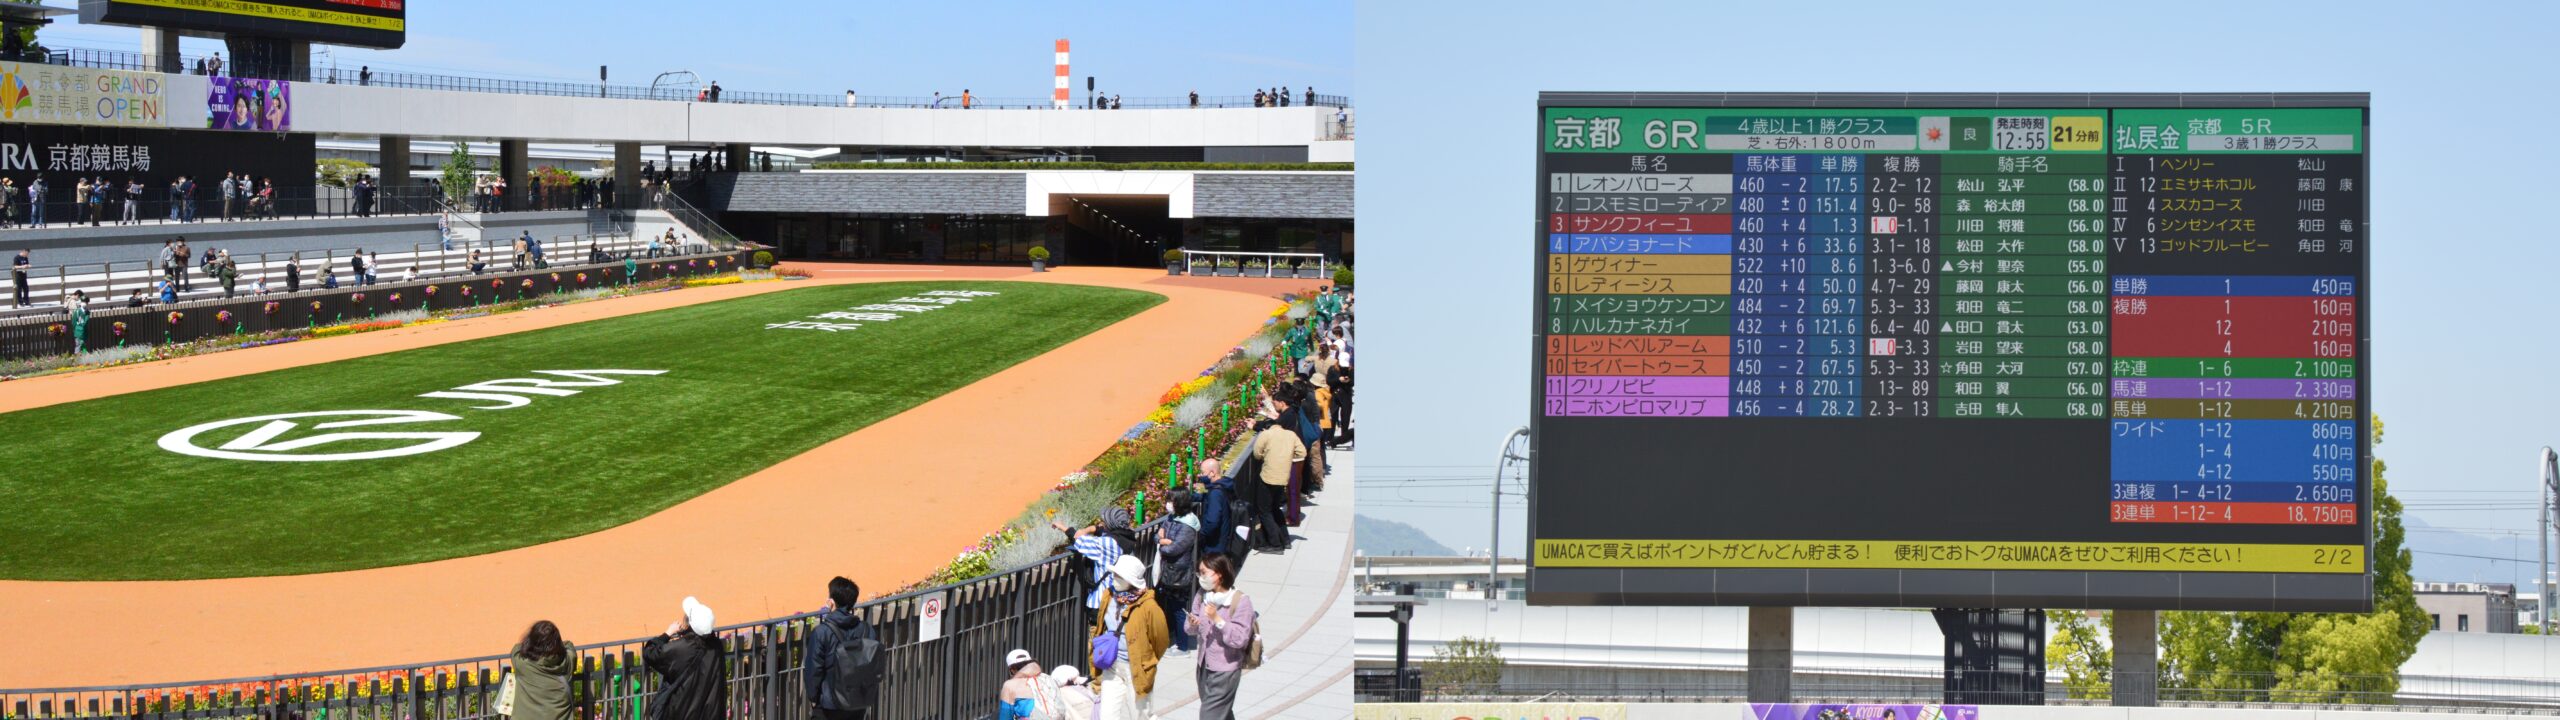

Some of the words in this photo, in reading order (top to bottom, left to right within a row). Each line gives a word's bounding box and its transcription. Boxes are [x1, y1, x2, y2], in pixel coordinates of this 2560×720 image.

[97, 75, 159, 94] GRAND
[214, 85, 226, 94] HERO
[218, 94, 224, 103] IS
[39, 95, 90, 115] 競馬場
[97, 97, 157, 119] OPEN
[1998, 118, 2043, 129] 発走時刻
[2188, 119, 2223, 136] 京都
[2240, 119, 2274, 136] 5R
[1555, 118, 1620, 148] 京都
[1645, 121, 1697, 147] 6R
[1738, 119, 1886, 135] 4歳以上1勝クラス
[1964, 128, 1976, 140] 良
[1997, 132, 2044, 150] 12:55
[2117, 126, 2179, 150] 払戻金
[2225, 137, 2318, 150] 3歳1勝クラス
[48, 143, 151, 171] 京都競馬場
[1631, 156, 1667, 171] 馬名
[1747, 156, 1796, 171] 馬体重
[1822, 156, 1857, 172] 単勝
[1884, 157, 1920, 172] 複勝
[1998, 156, 2048, 172] 騎手名
[2160, 159, 2214, 173] ヘンリー
[2298, 158, 2325, 171] 松山
[1573, 176, 1693, 193] レオンバローズ
[1740, 177, 1764, 192] 460
[1826, 178, 1857, 192] 17.5
[1958, 179, 1984, 191] 松山
[1998, 179, 2024, 192] 弘平
[2069, 179, 2104, 192] (58.0)
[2141, 177, 2155, 192] 12
[2162, 178, 2255, 190] エミサキホコル
[2298, 178, 2324, 191] 藤岡
[2340, 179, 2352, 191] 康
[1576, 197, 1726, 212] コスモミローディア
[1740, 197, 1763, 212] 480
[1817, 198, 1856, 213] 151.4
[1957, 199, 1970, 211] 森
[1984, 199, 2024, 212] 裕太朗
[2069, 199, 2104, 212] (58.0)
[2298, 199, 2324, 211] 川田
[1576, 217, 1692, 232] サンクフィーユ
[1740, 218, 1763, 232] 460
[1834, 218, 1856, 233] 1.3
[1871, 218, 1930, 234] 1.0-1.1
[1957, 220, 1983, 232] 川田
[2068, 219, 2103, 232] (56.0)
[2298, 219, 2324, 232] 和田
[2340, 219, 2352, 232] 竜
[1739, 238, 1763, 253] 430
[1825, 238, 1856, 253] 33.6
[1957, 240, 1983, 252] 松田
[1998, 240, 2024, 252] 大作
[2068, 240, 2103, 252] (58.0)
[2140, 238, 2155, 253] 13
[2299, 239, 2324, 252] 角田
[2340, 240, 2352, 252] 河
[1571, 257, 1657, 274] ゲヴィナー
[1739, 258, 1762, 273] 522
[1832, 258, 1856, 273] 8.6
[1870, 258, 1930, 274] 1.3-6.0
[1957, 260, 1983, 273] 今村
[2068, 260, 2103, 273] (55.0)
[1571, 277, 1673, 294] レディーシス
[1738, 278, 1762, 293] 420
[1824, 279, 1856, 293] 50.0
[1957, 280, 1983, 292] 藤岡
[1997, 280, 2024, 293] 康太
[2068, 280, 2103, 293] (56.0)
[2115, 279, 2146, 294] 単勝
[2312, 279, 2351, 295] 450円
[1575, 298, 1724, 313] メイショウケンコン
[1738, 298, 1761, 313] 484
[1823, 298, 1855, 314] 69.7
[1956, 301, 1982, 313] 和田
[1997, 300, 2024, 313] 竜二
[2068, 301, 2103, 314] (58.0)
[2114, 299, 2146, 314] 複勝
[2314, 300, 2351, 315] 160円
[1573, 318, 1690, 333] ハルカナネガイ
[1738, 319, 1761, 334] 432
[1816, 319, 1855, 334] 121.6
[1956, 321, 1982, 333] 田口
[1997, 321, 2023, 334] 貫太
[2068, 321, 2103, 334] (53.0)
[2217, 320, 2231, 335] 12
[2313, 320, 2351, 336] 210円
[1570, 338, 1707, 355] レッドベルアーム
[1738, 339, 1761, 354] 510
[1831, 339, 1855, 354] 5.3
[1868, 339, 1929, 355] 1.0-3.3
[1956, 341, 1982, 353] 岩田
[1997, 341, 2023, 354] 望来
[2068, 341, 2103, 355] (58.0)
[2314, 341, 2351, 356] 160円
[1737, 359, 1761, 374] 450
[1822, 360, 1854, 375] 67.5
[1956, 362, 1982, 374] 角田
[1997, 362, 2023, 375] 大河
[2068, 362, 2103, 375] (57.0)
[2114, 360, 2146, 375] 枠連
[2295, 361, 2352, 377] 2,100円
[417, 369, 671, 410] JRA
[1736, 380, 1760, 395] 448
[1813, 380, 1852, 395] 270.1
[1956, 382, 1981, 394] 和田
[1997, 382, 2009, 395] 翼
[2067, 382, 2103, 395] (56.0)
[2114, 381, 2146, 396] 馬連
[2199, 381, 2231, 396] 1-12
[2295, 382, 2352, 398] 2,330円
[1736, 400, 1761, 416] 456
[1821, 401, 1854, 416] 28.2
[1956, 402, 1981, 415] 吉田
[1997, 402, 2023, 415] 隼人
[2067, 403, 2102, 416] (58.0)
[2114, 401, 2146, 416] 馬単
[2200, 402, 2231, 417] 1-12
[2295, 402, 2352, 418] 4,210円
[2115, 422, 2164, 437] ワイド
[2200, 423, 2231, 438] 1-12
[2313, 423, 2352, 439] 860円
[2313, 444, 2352, 460] 410円
[2198, 464, 2231, 479] 4-12
[2313, 465, 2352, 481] 550円
[2114, 484, 2155, 499] 3連複
[2296, 485, 2352, 502] 2,650円
[2114, 504, 2154, 520] 3連単
[2288, 506, 2352, 522] 18,750円
[1541, 542, 1872, 562] UMACAで買えばポイントがどんどん貯まる!
[1894, 543, 2242, 565] 便利でおトクなUMACAをぜひご利用ください!
[2314, 548, 2353, 565] 2/2
[1855, 706, 1884, 718] KYOTO
